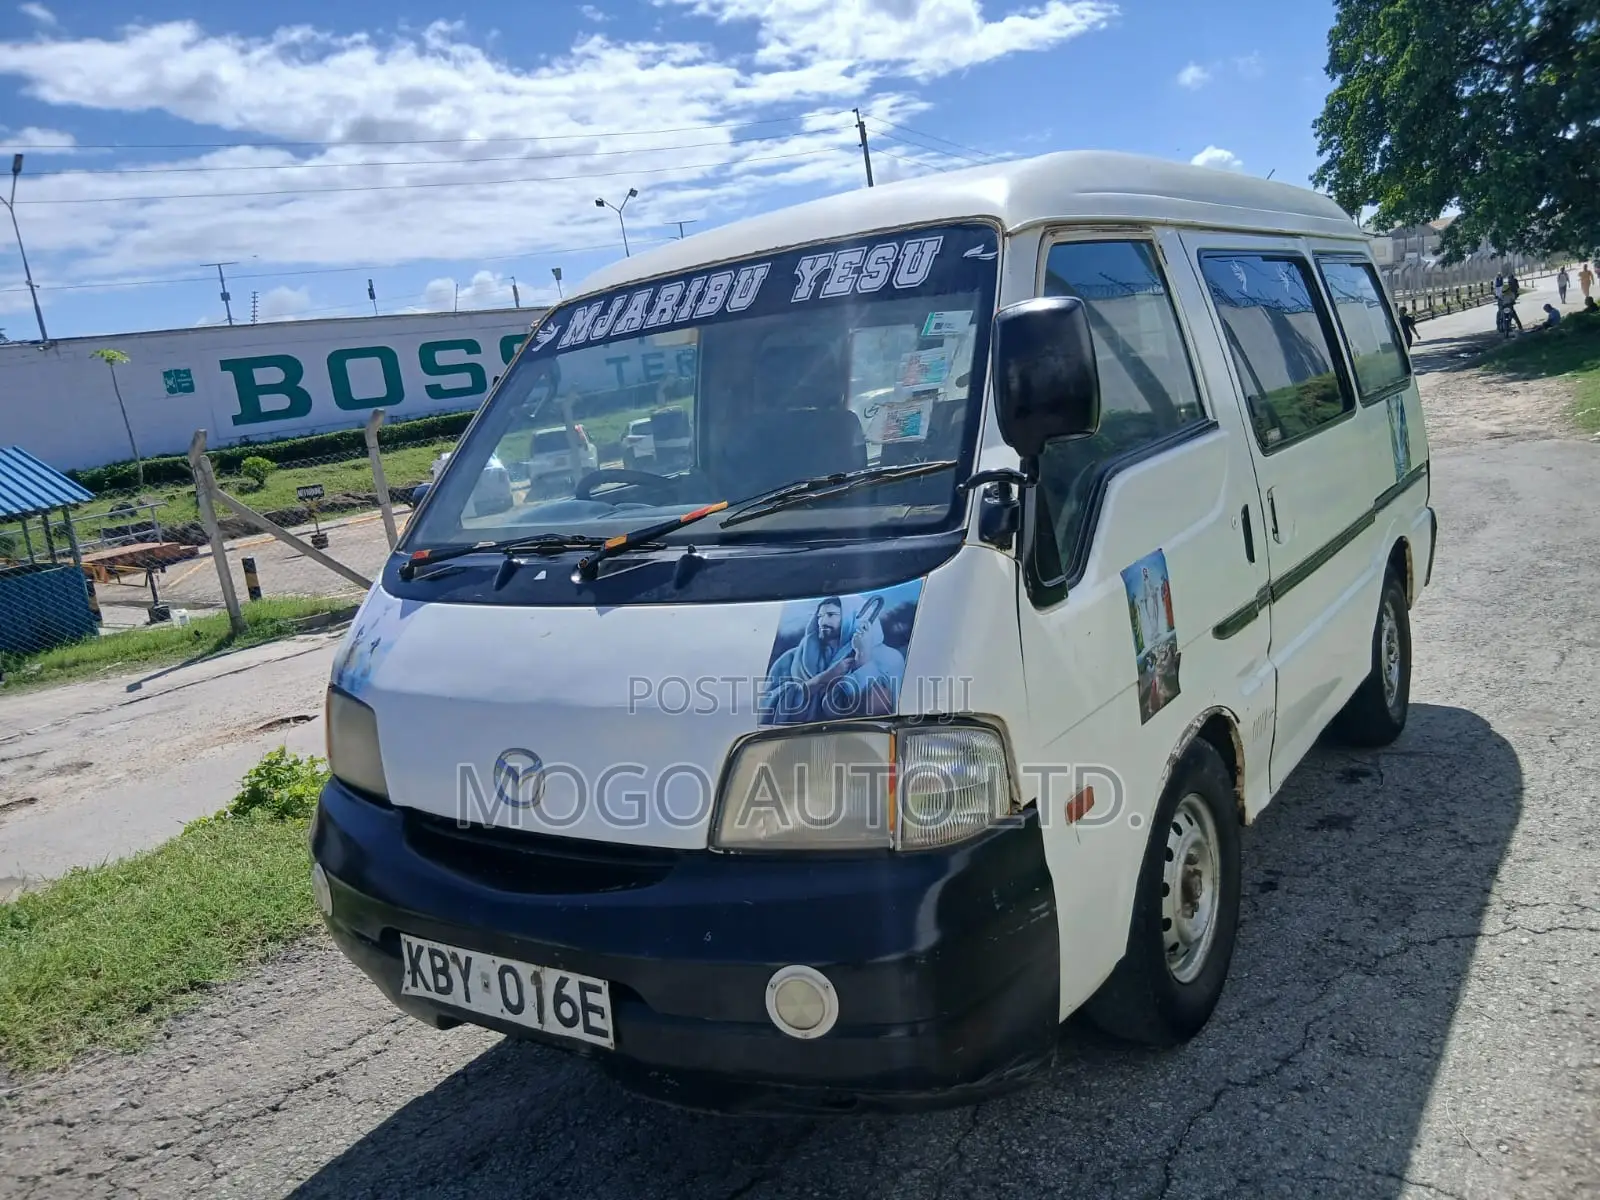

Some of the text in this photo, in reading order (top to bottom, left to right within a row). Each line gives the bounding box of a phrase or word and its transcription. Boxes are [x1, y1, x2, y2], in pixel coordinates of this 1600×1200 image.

[556, 235, 944, 350] MJARIBU YESU
[406, 941, 609, 1039] KBY 016E
